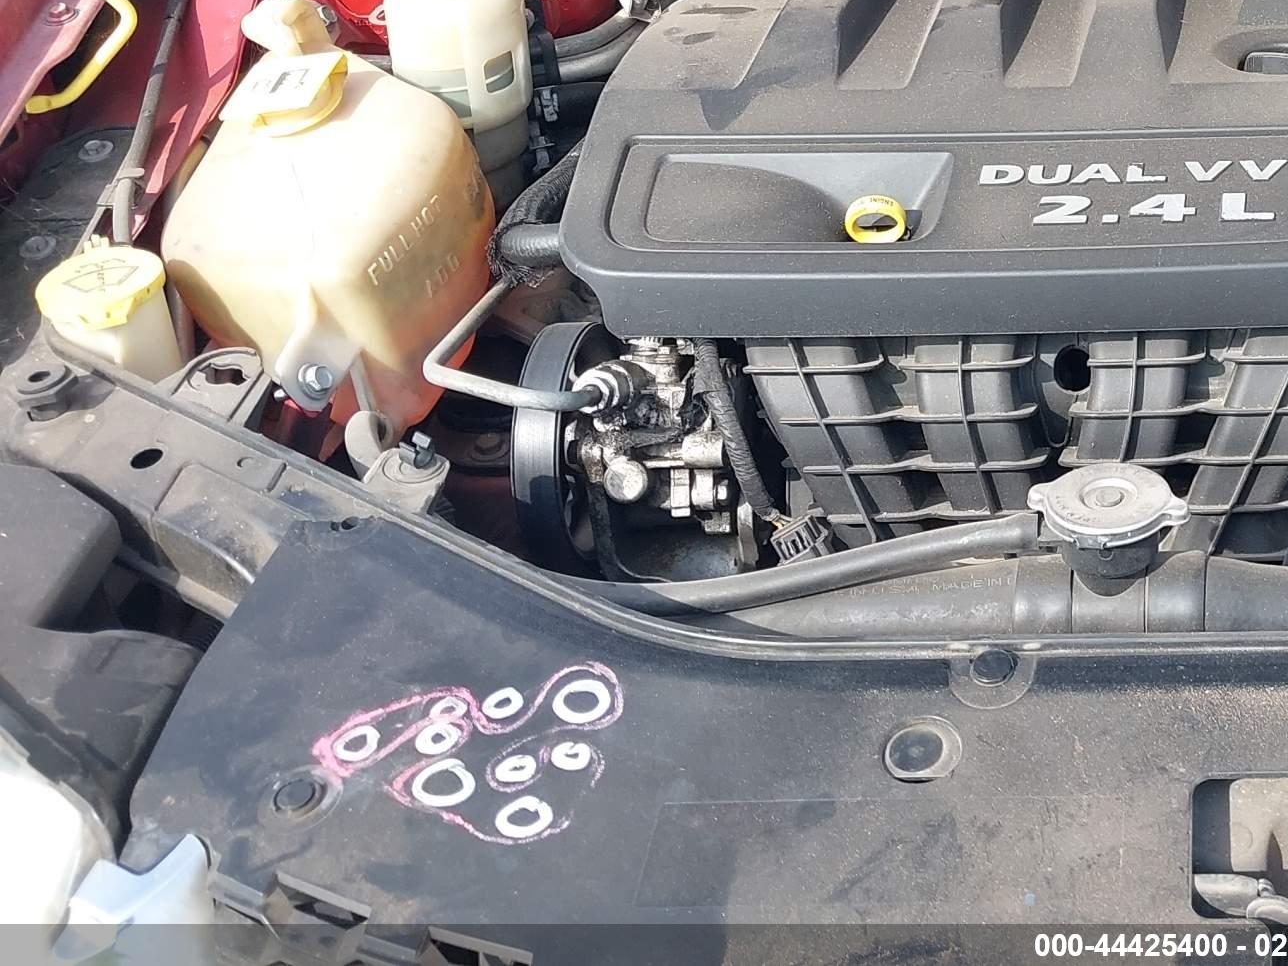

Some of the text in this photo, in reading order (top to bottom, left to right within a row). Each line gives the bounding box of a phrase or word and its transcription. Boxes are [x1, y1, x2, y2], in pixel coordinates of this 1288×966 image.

[979, 163, 1167, 185] DUAL
[1032, 192, 1276, 226] 2.4 L
[367, 194, 440, 286] FULL HOT
